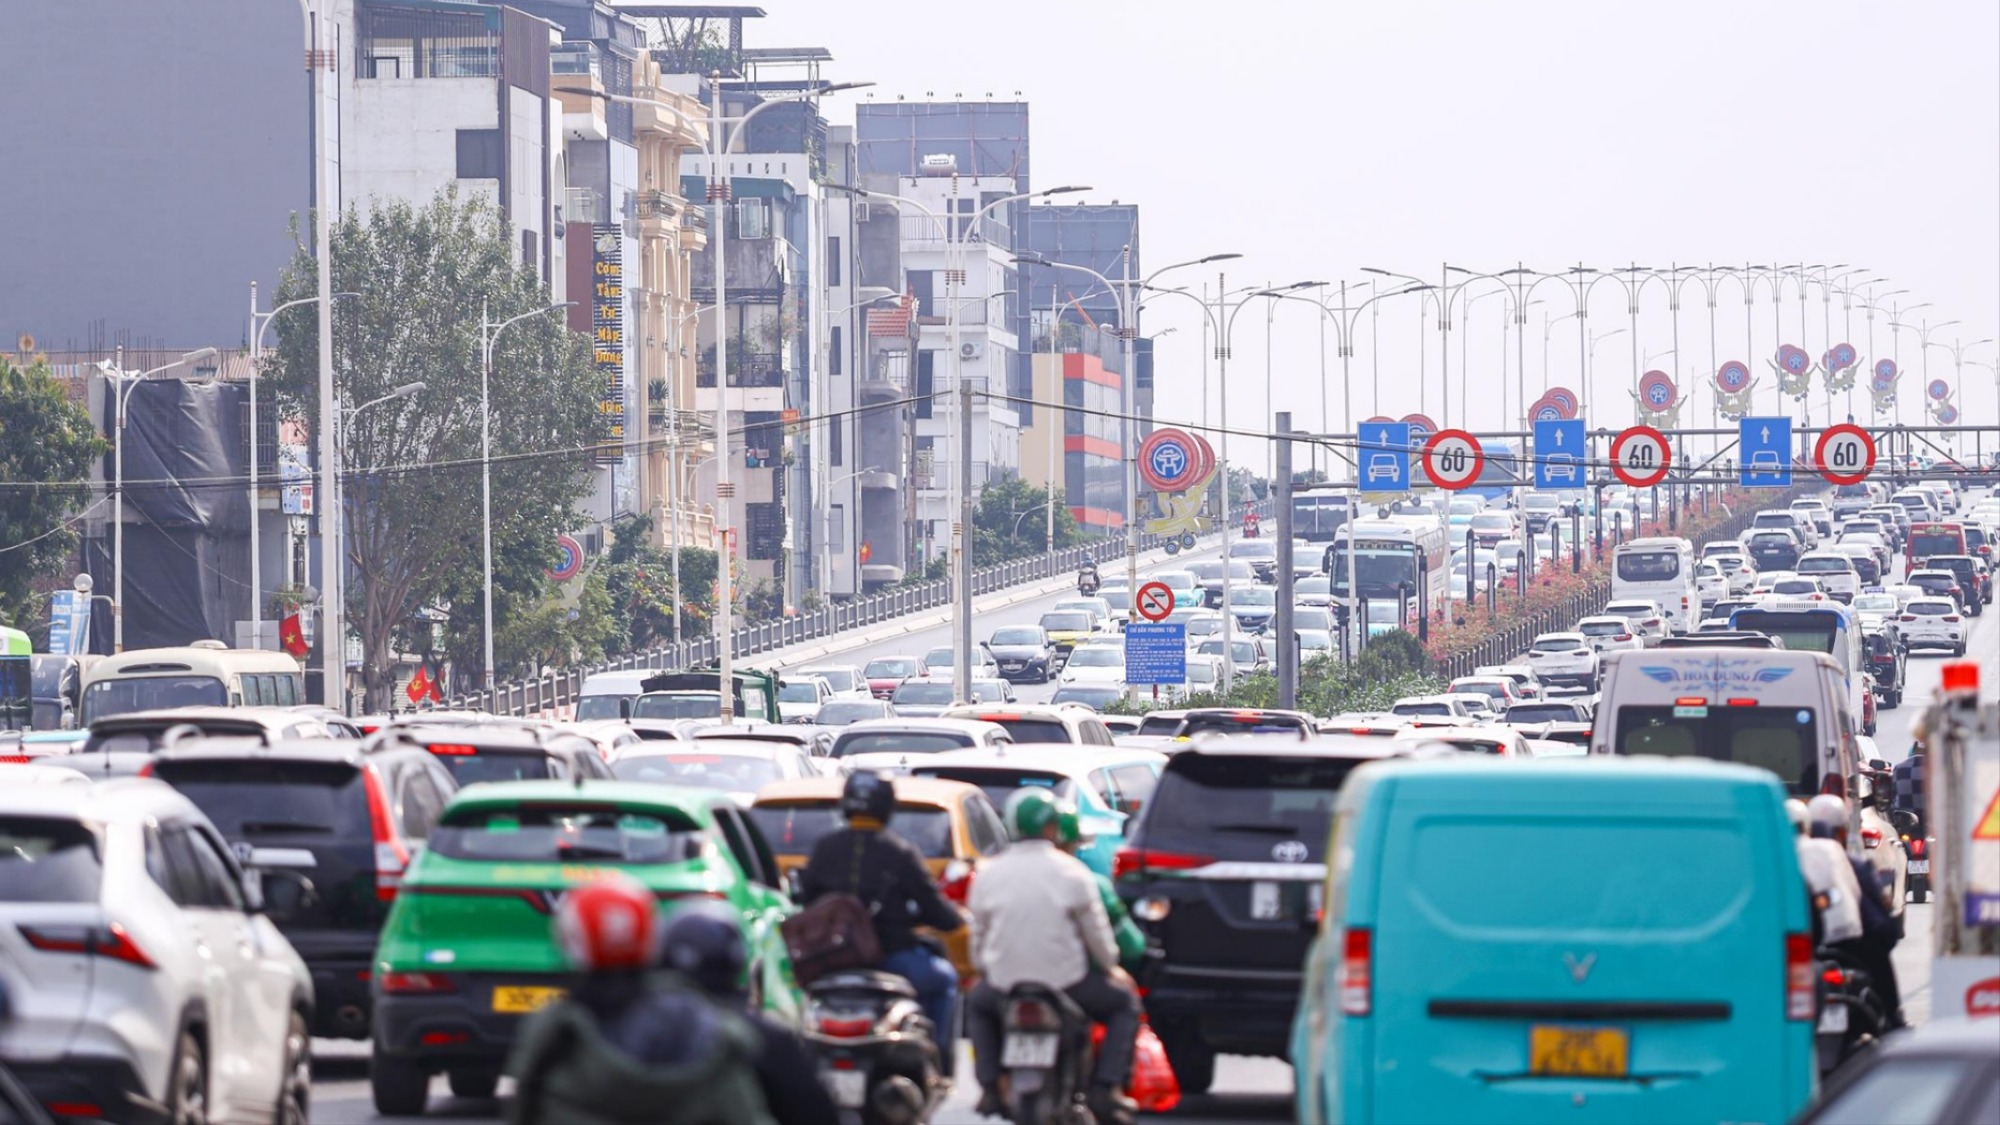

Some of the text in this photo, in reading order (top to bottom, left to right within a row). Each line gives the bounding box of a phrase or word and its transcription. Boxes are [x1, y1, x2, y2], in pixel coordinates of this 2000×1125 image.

[1441, 446, 1465, 472] 60
[1629, 444, 1653, 469] 60
[1834, 442, 1857, 467] 60
